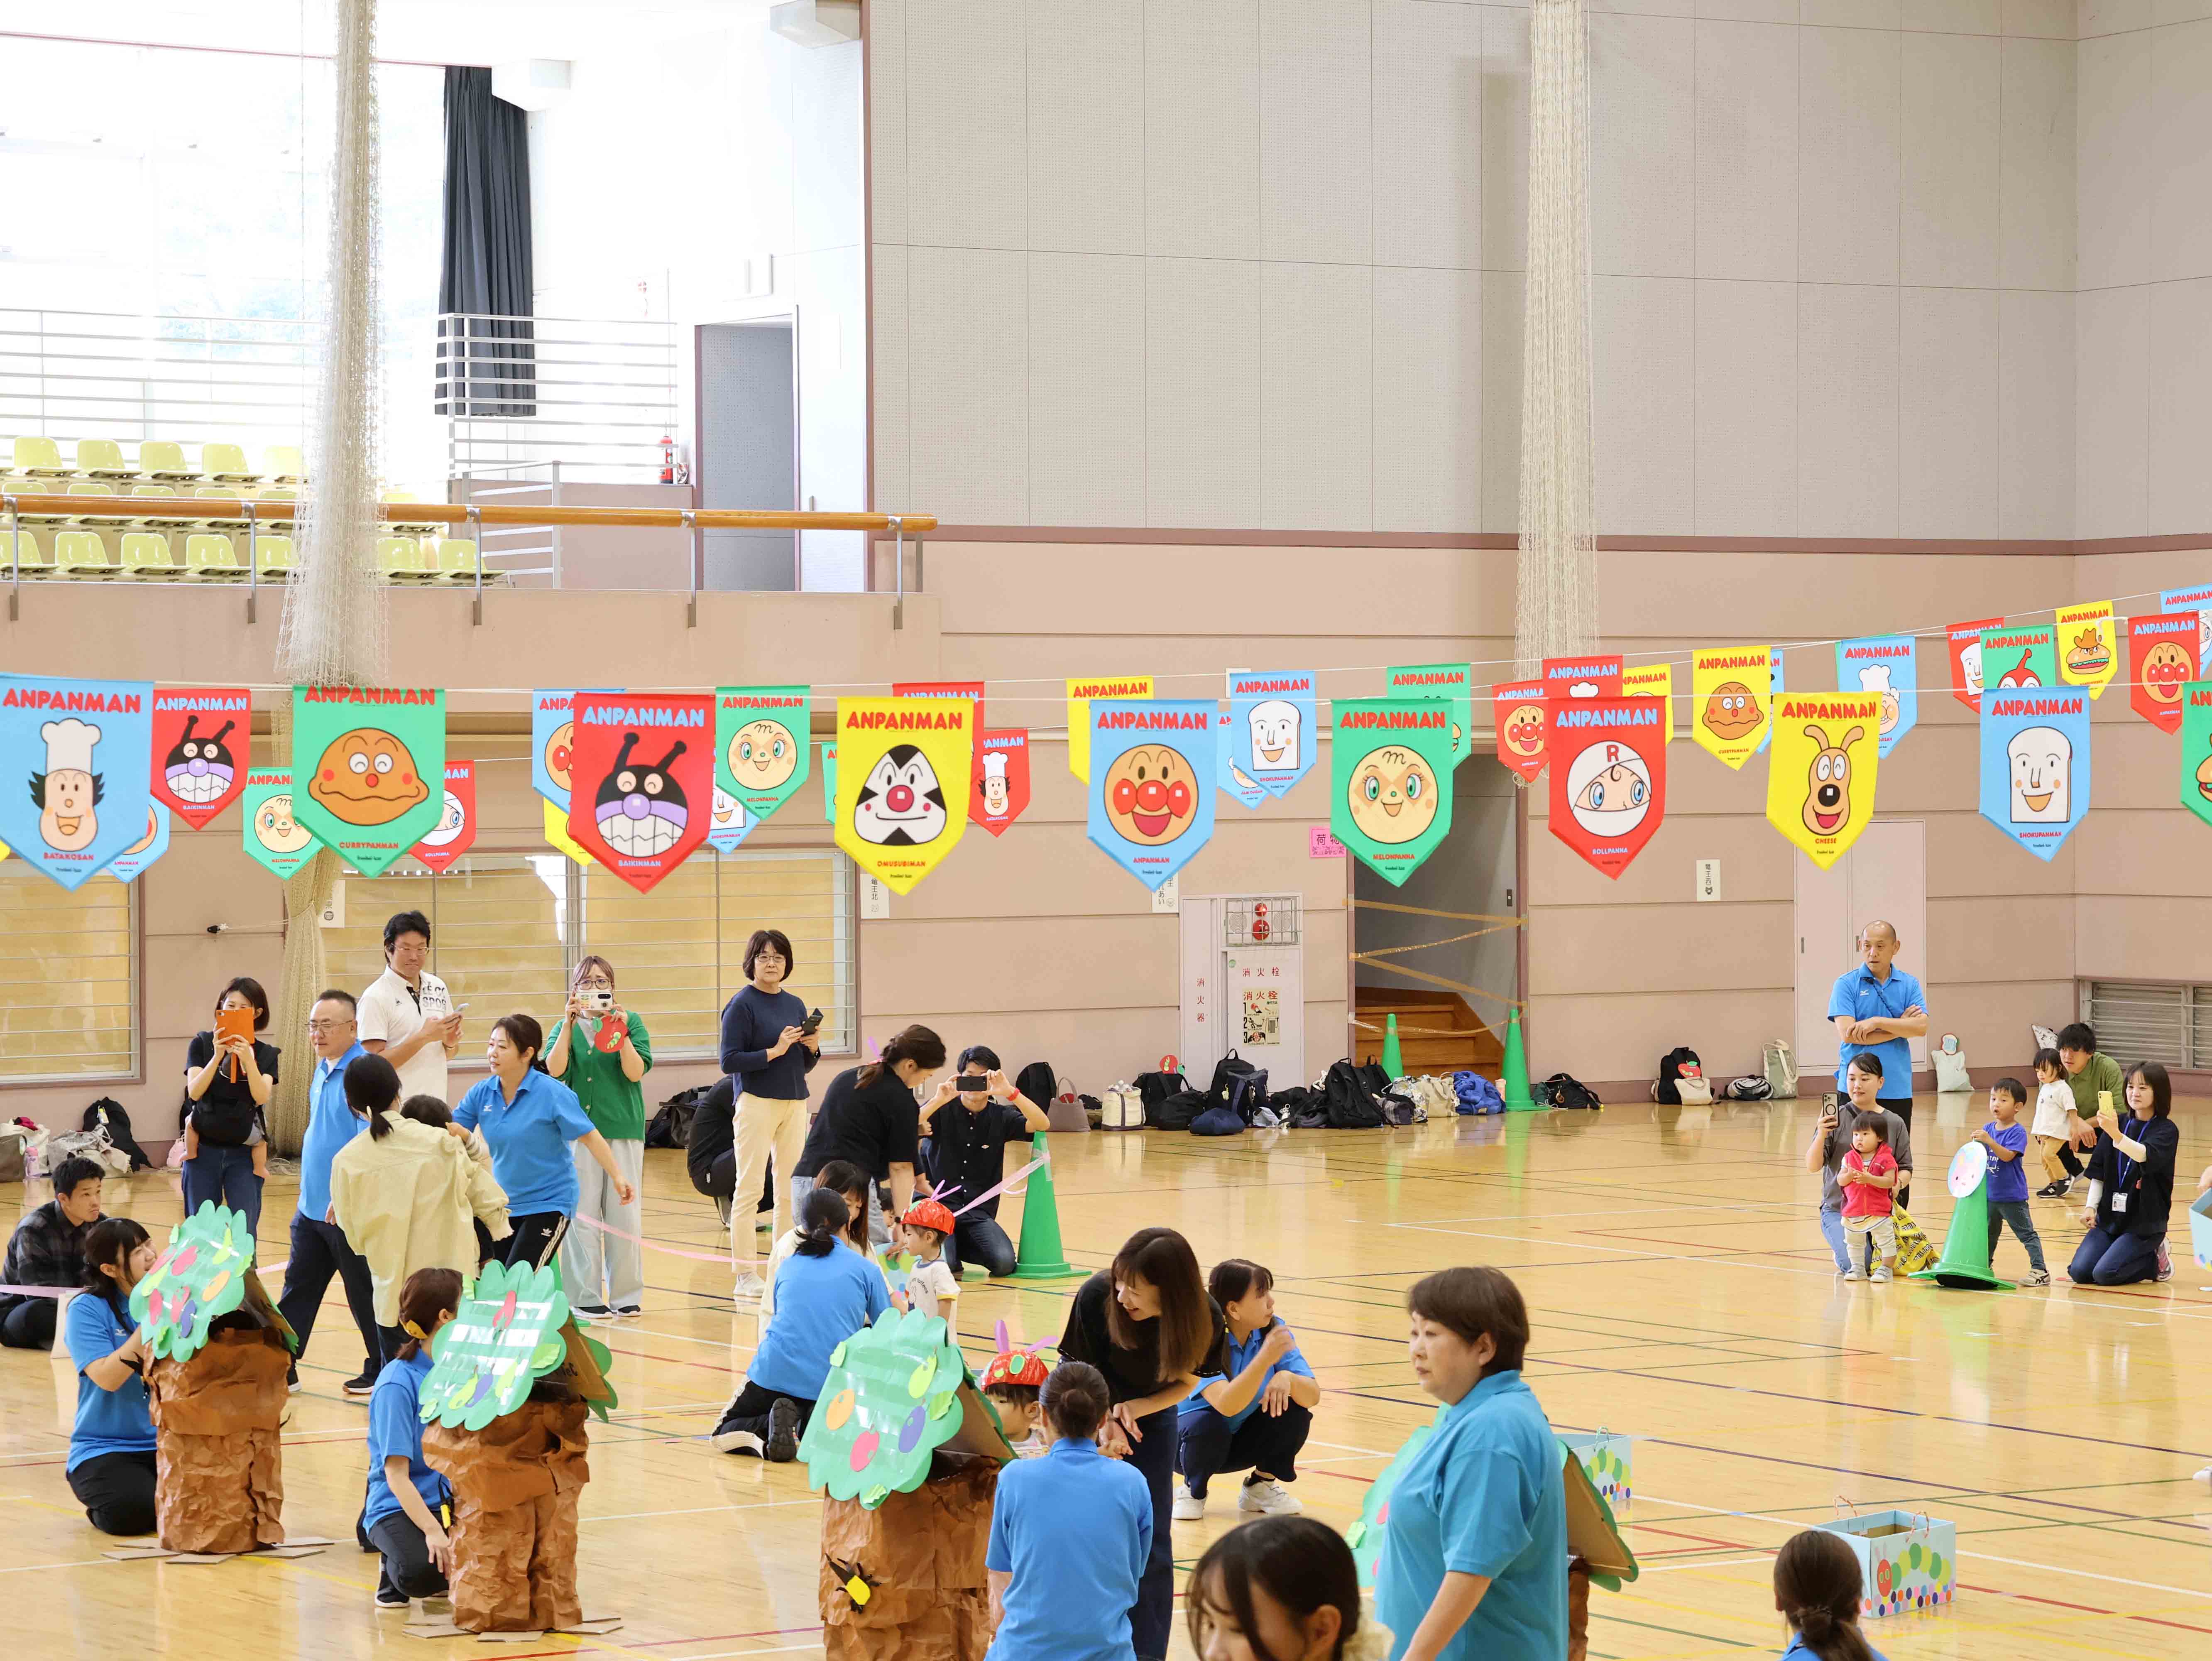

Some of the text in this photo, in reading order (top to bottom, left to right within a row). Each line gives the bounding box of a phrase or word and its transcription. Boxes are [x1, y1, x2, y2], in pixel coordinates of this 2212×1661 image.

[2061, 608, 2109, 622] ANPANMAN
[2134, 620, 2195, 635] ANPANMAN
[1985, 633, 2048, 649] ANPANMAN
[1845, 646, 1909, 659] ANPANMAN
[1698, 655, 1764, 669] ANPANMAN
[1393, 672, 1463, 685] ANPANMAN
[1549, 664, 1617, 679] ANPANMAN
[1236, 678, 1309, 693] ANPANMAN
[1622, 673, 1666, 685] NPANMAN
[304, 686, 435, 705] ANPANMAN
[1074, 682, 1147, 698] ANPANMAN
[1498, 688, 1544, 701] ANPANMA
[3, 688, 140, 713] ANPANMAN
[155, 698, 246, 710] ANPANMAN
[540, 697, 574, 710] ANPA
[723, 695, 803, 709] ANPANMAN
[1992, 699, 2082, 715] ANPANMAN
[582, 706, 705, 727] ANPANMAN
[1782, 702, 1876, 718] ANPANMAN
[847, 711, 962, 730] ANPANMAN
[1098, 712, 1207, 730] ANPANMAN
[1340, 712, 1445, 728] ANPANMAN
[1557, 708, 1657, 728] ANPANMAN
[984, 737, 1023, 748] ANMAN
[1607, 745, 1618, 762] R
[248, 775, 292, 785] ANPAN
[1243, 966, 1279, 976] 消火栓
[1243, 991, 1277, 1000] 消火栓
[1243, 1017, 1247, 1029] 2
[1244, 1031, 1248, 1044] 3
